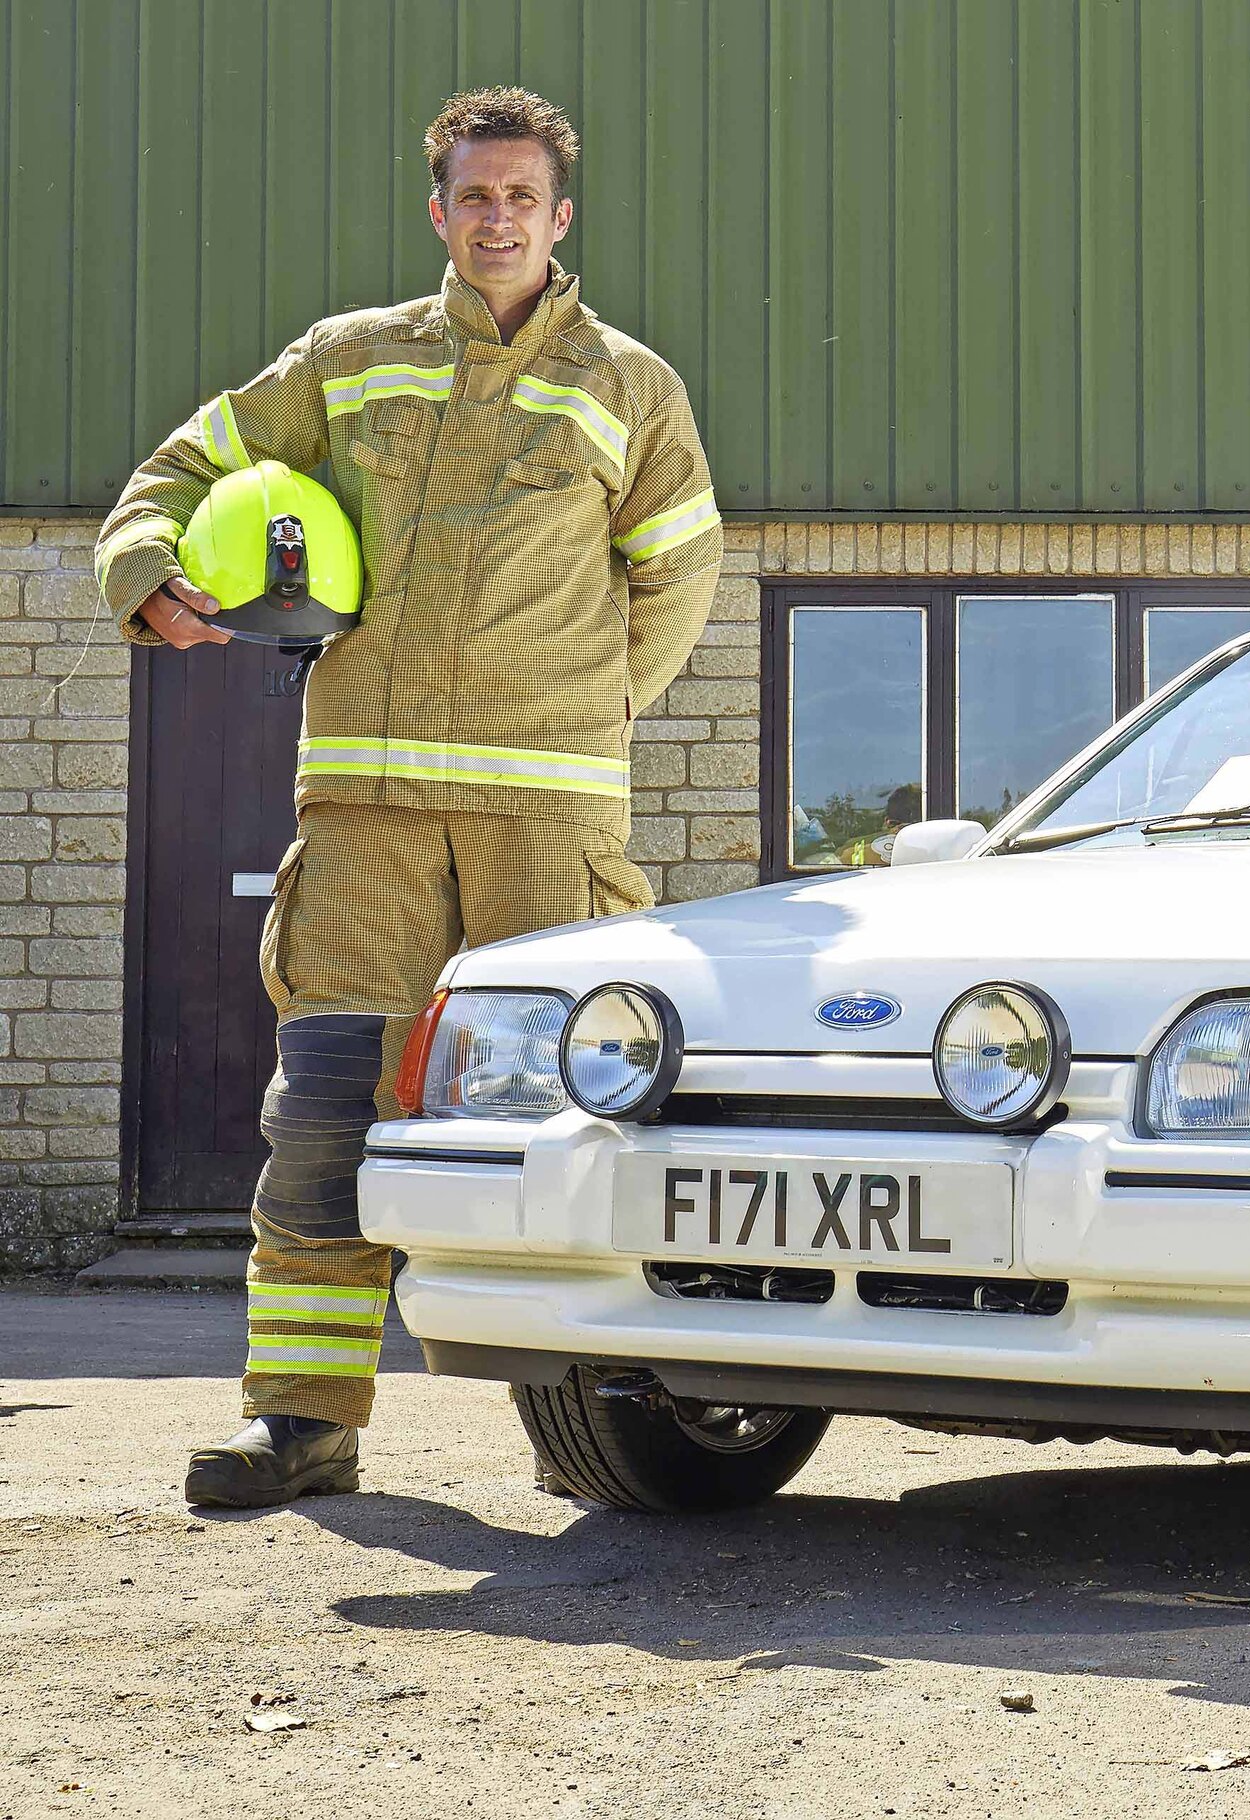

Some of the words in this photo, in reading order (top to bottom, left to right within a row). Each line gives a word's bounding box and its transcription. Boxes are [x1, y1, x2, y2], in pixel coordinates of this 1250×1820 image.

[831, 999, 879, 1020] Ford
[664, 1168, 788, 1246] F171
[811, 1172, 951, 1254] XRL
